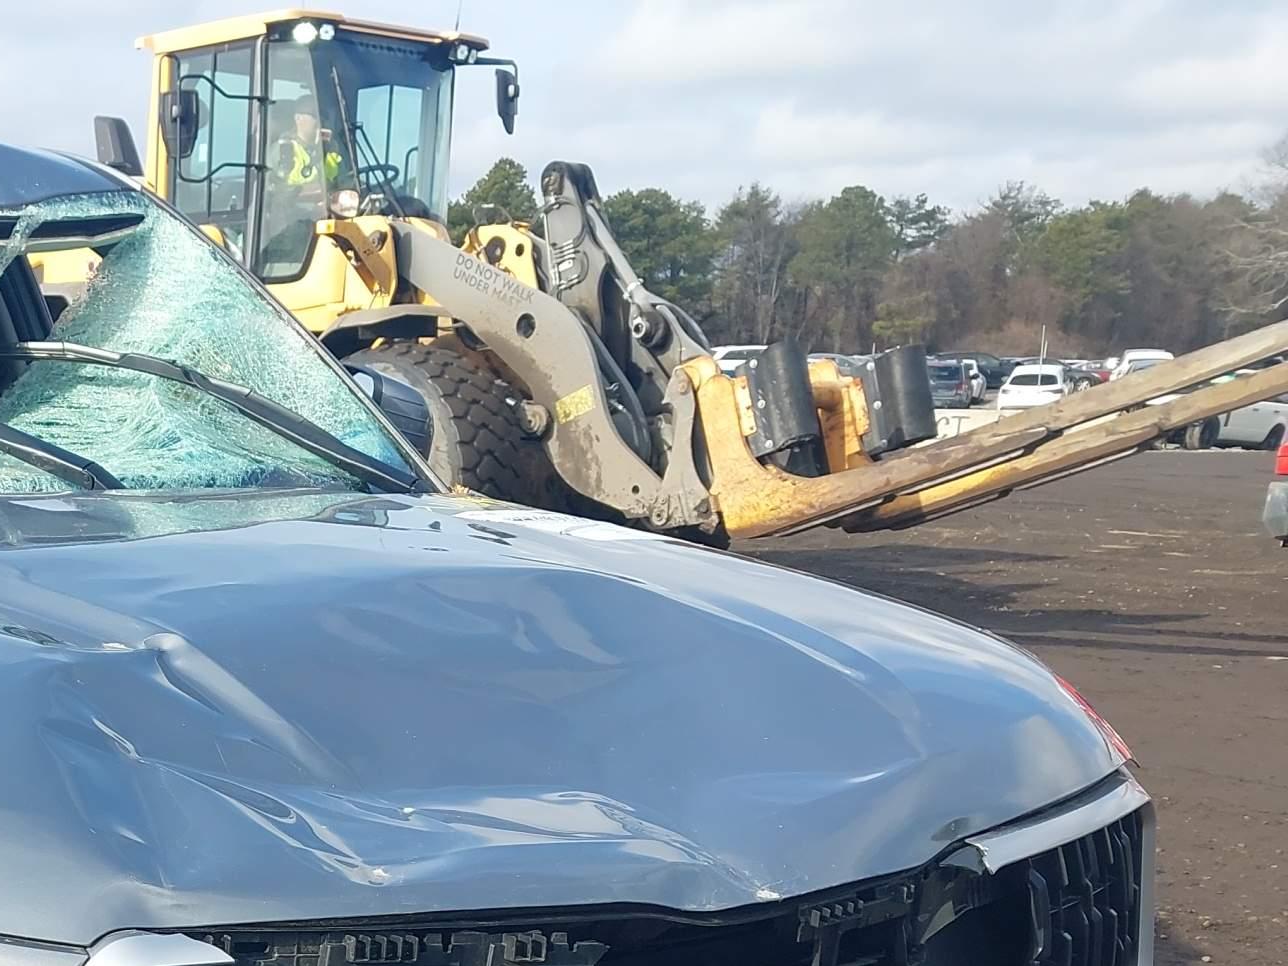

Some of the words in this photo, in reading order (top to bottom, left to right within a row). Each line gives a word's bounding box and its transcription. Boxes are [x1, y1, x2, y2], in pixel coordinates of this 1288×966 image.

[454, 267, 489, 294] UNDER
[456, 254, 473, 270] DO
[475, 263, 501, 284] NOT
[503, 277, 534, 304] WALK
